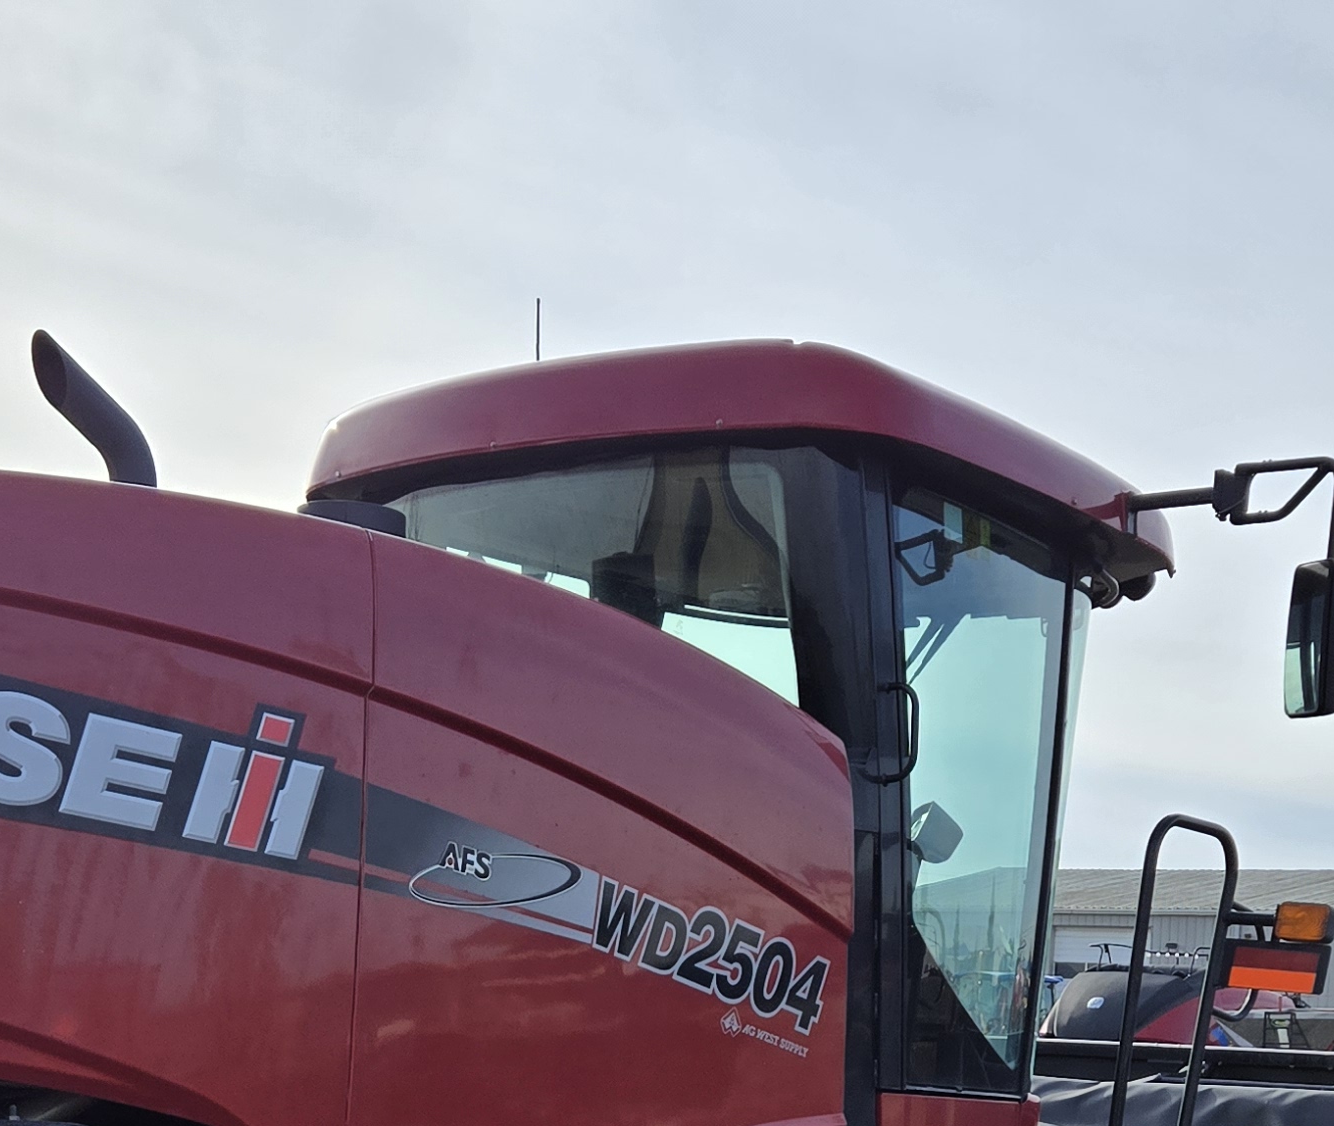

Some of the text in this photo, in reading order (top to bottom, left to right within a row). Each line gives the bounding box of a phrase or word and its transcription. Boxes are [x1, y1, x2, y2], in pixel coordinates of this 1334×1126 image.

[438, 841, 492, 881] AFS
[592, 875, 831, 1036] WD2504
[756, 1029, 780, 1047] WEST
